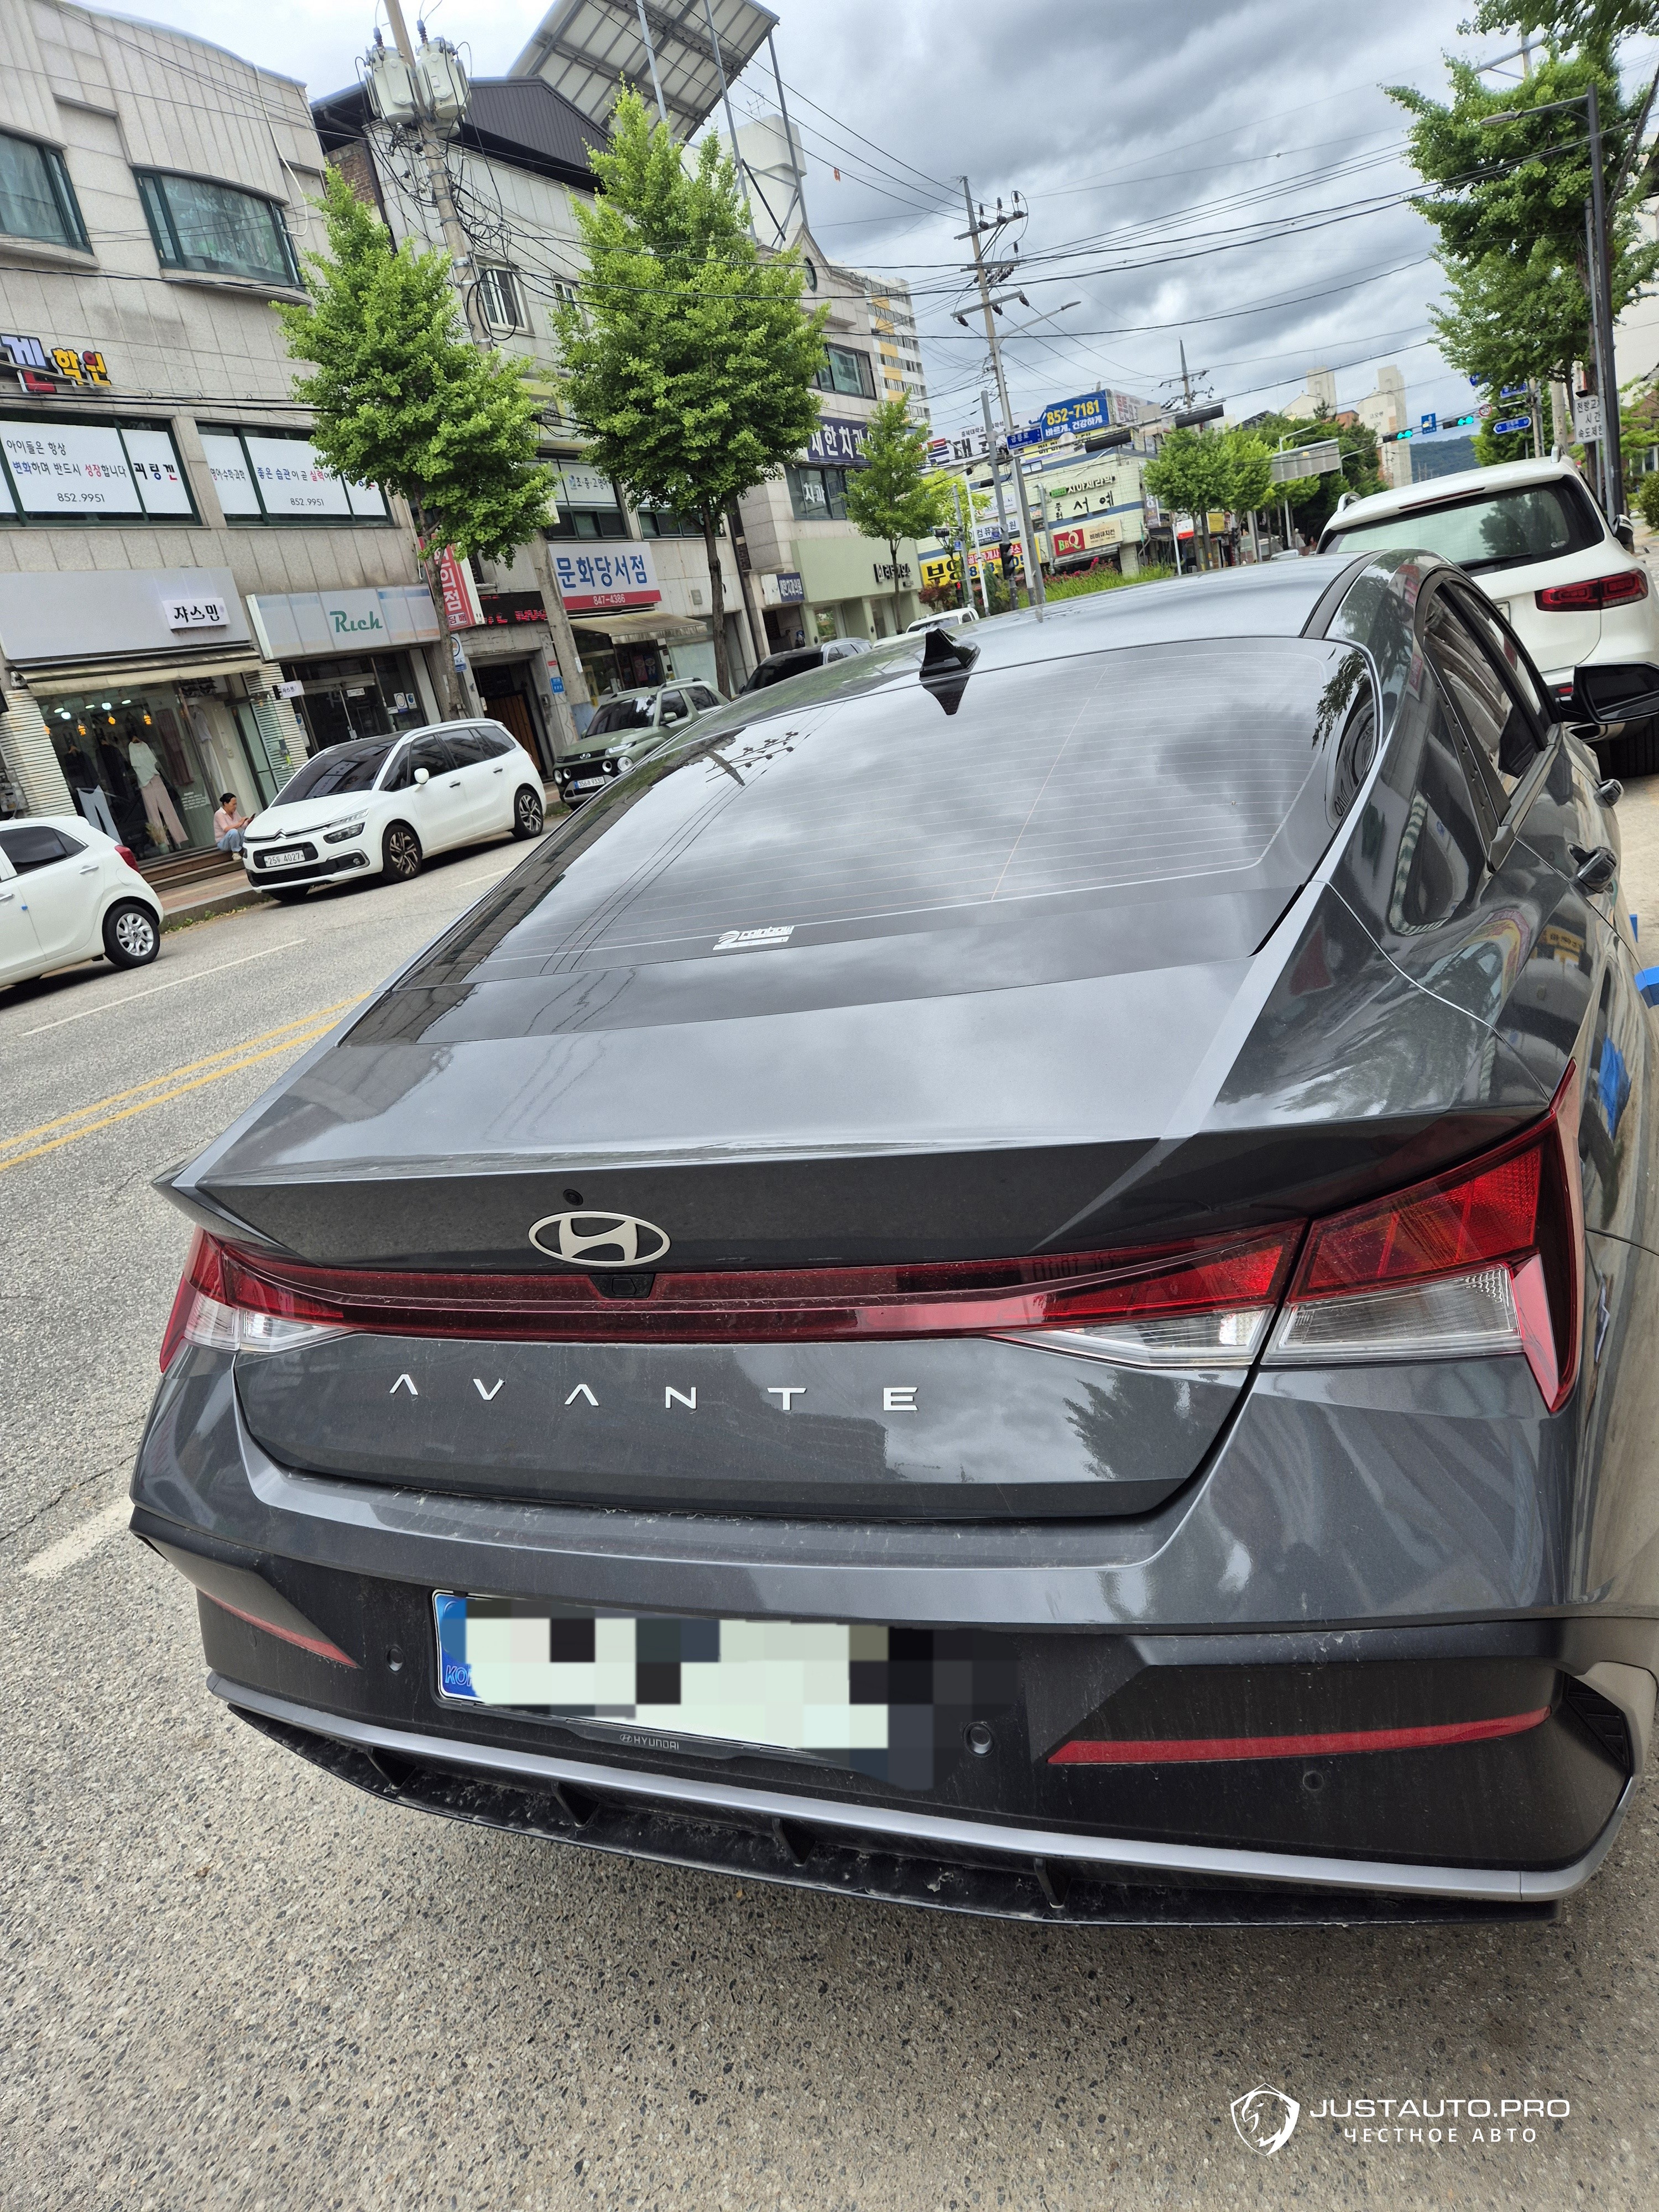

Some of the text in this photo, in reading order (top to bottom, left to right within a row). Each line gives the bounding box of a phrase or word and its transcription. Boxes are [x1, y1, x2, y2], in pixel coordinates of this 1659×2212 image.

[1046, 399, 1100, 425] 852-7181
[1045, 415, 1103, 436] 바르게, 건강하게
[7, 440, 66, 456] 아이들은 항상
[13, 461, 127, 478] 변화하며 반드시 성장합니다
[257, 467, 273, 480] 좋은
[275, 469, 300, 481] 습관이
[301, 471, 308, 481] 곧
[57, 493, 105, 502] 852.9951
[290, 498, 324, 506] 852.9951
[804, 483, 826, 504] 치과
[1073, 490, 1114, 513] 서예
[1058, 530, 1082, 552] BBQ
[556, 555, 648, 588] 문화당서점
[593, 594, 625, 606] 847-4386
[330, 611, 383, 633] Rich
[448, 614, 466, 625] 담배
[284, 853, 300, 862] 4027
[389, 1374, 918, 1412] AVANTE
[634, 1735, 679, 1750] HYUNDAI
